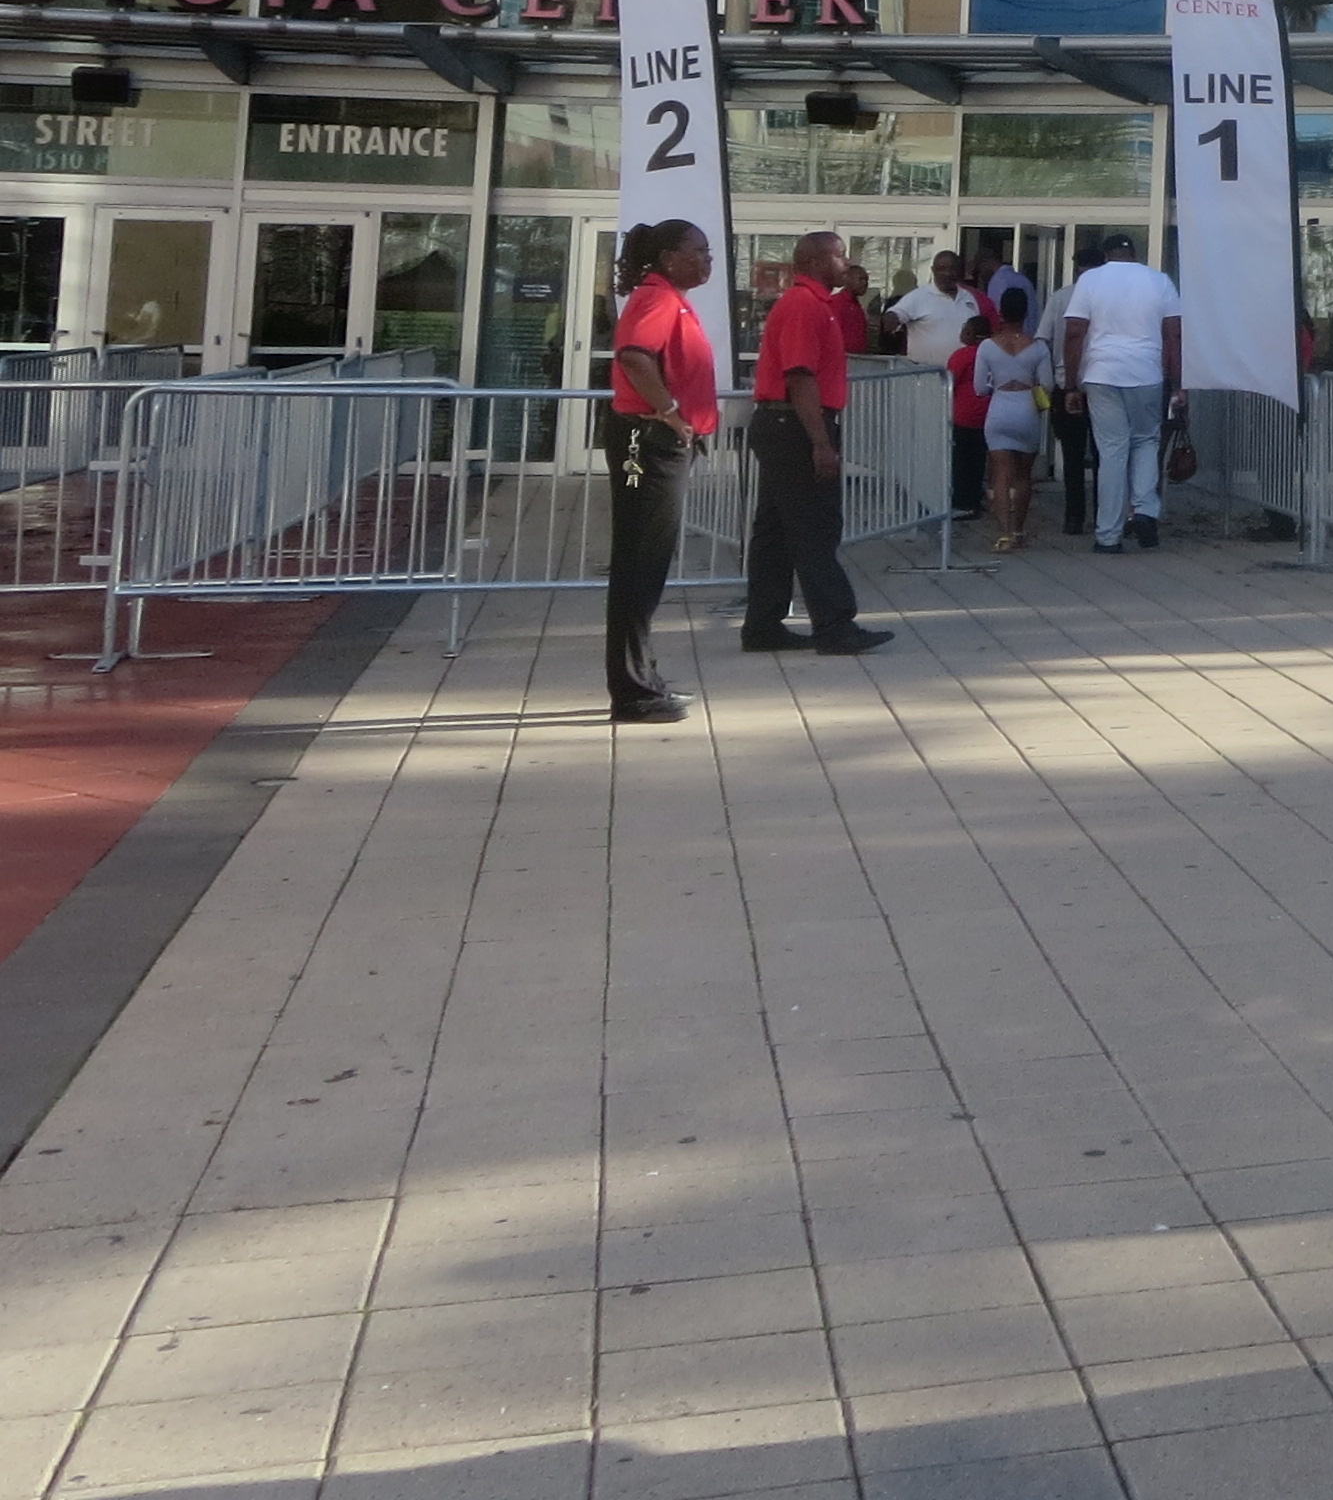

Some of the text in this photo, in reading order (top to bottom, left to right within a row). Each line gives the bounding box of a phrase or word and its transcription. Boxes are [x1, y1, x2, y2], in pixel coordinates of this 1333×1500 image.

[1176, 0, 1259, 18] CENTER
[630, 45, 701, 89] LINE
[1183, 73, 1274, 105] LINE
[35, 113, 449, 158] STREET ENTRANCE
[646, 100, 696, 172] 2
[1197, 118, 1239, 182] 1
